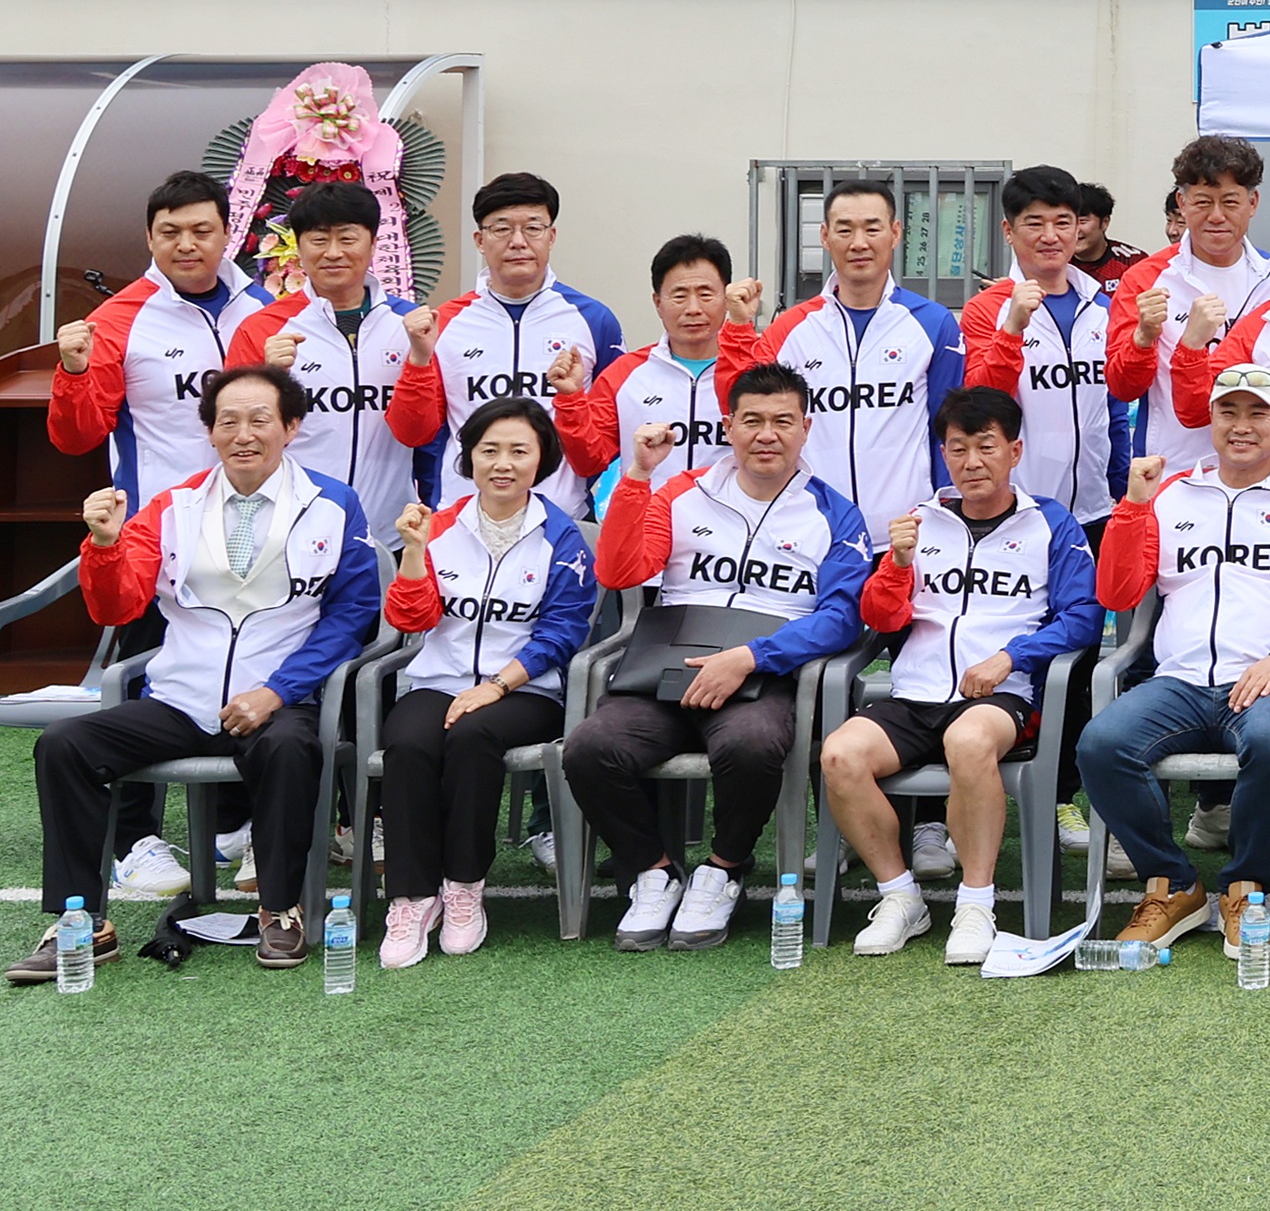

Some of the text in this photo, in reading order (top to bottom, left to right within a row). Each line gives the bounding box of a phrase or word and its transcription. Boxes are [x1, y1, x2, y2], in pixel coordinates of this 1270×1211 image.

[467, 371, 552, 402] KORE
[1029, 360, 1105, 390] KORE
[308, 384, 394, 414] KORE
[809, 382, 914, 414] KOREA
[690, 552, 816, 596] KOREA
[921, 567, 1032, 599] KOREA
[442, 595, 543, 624] KOREA
